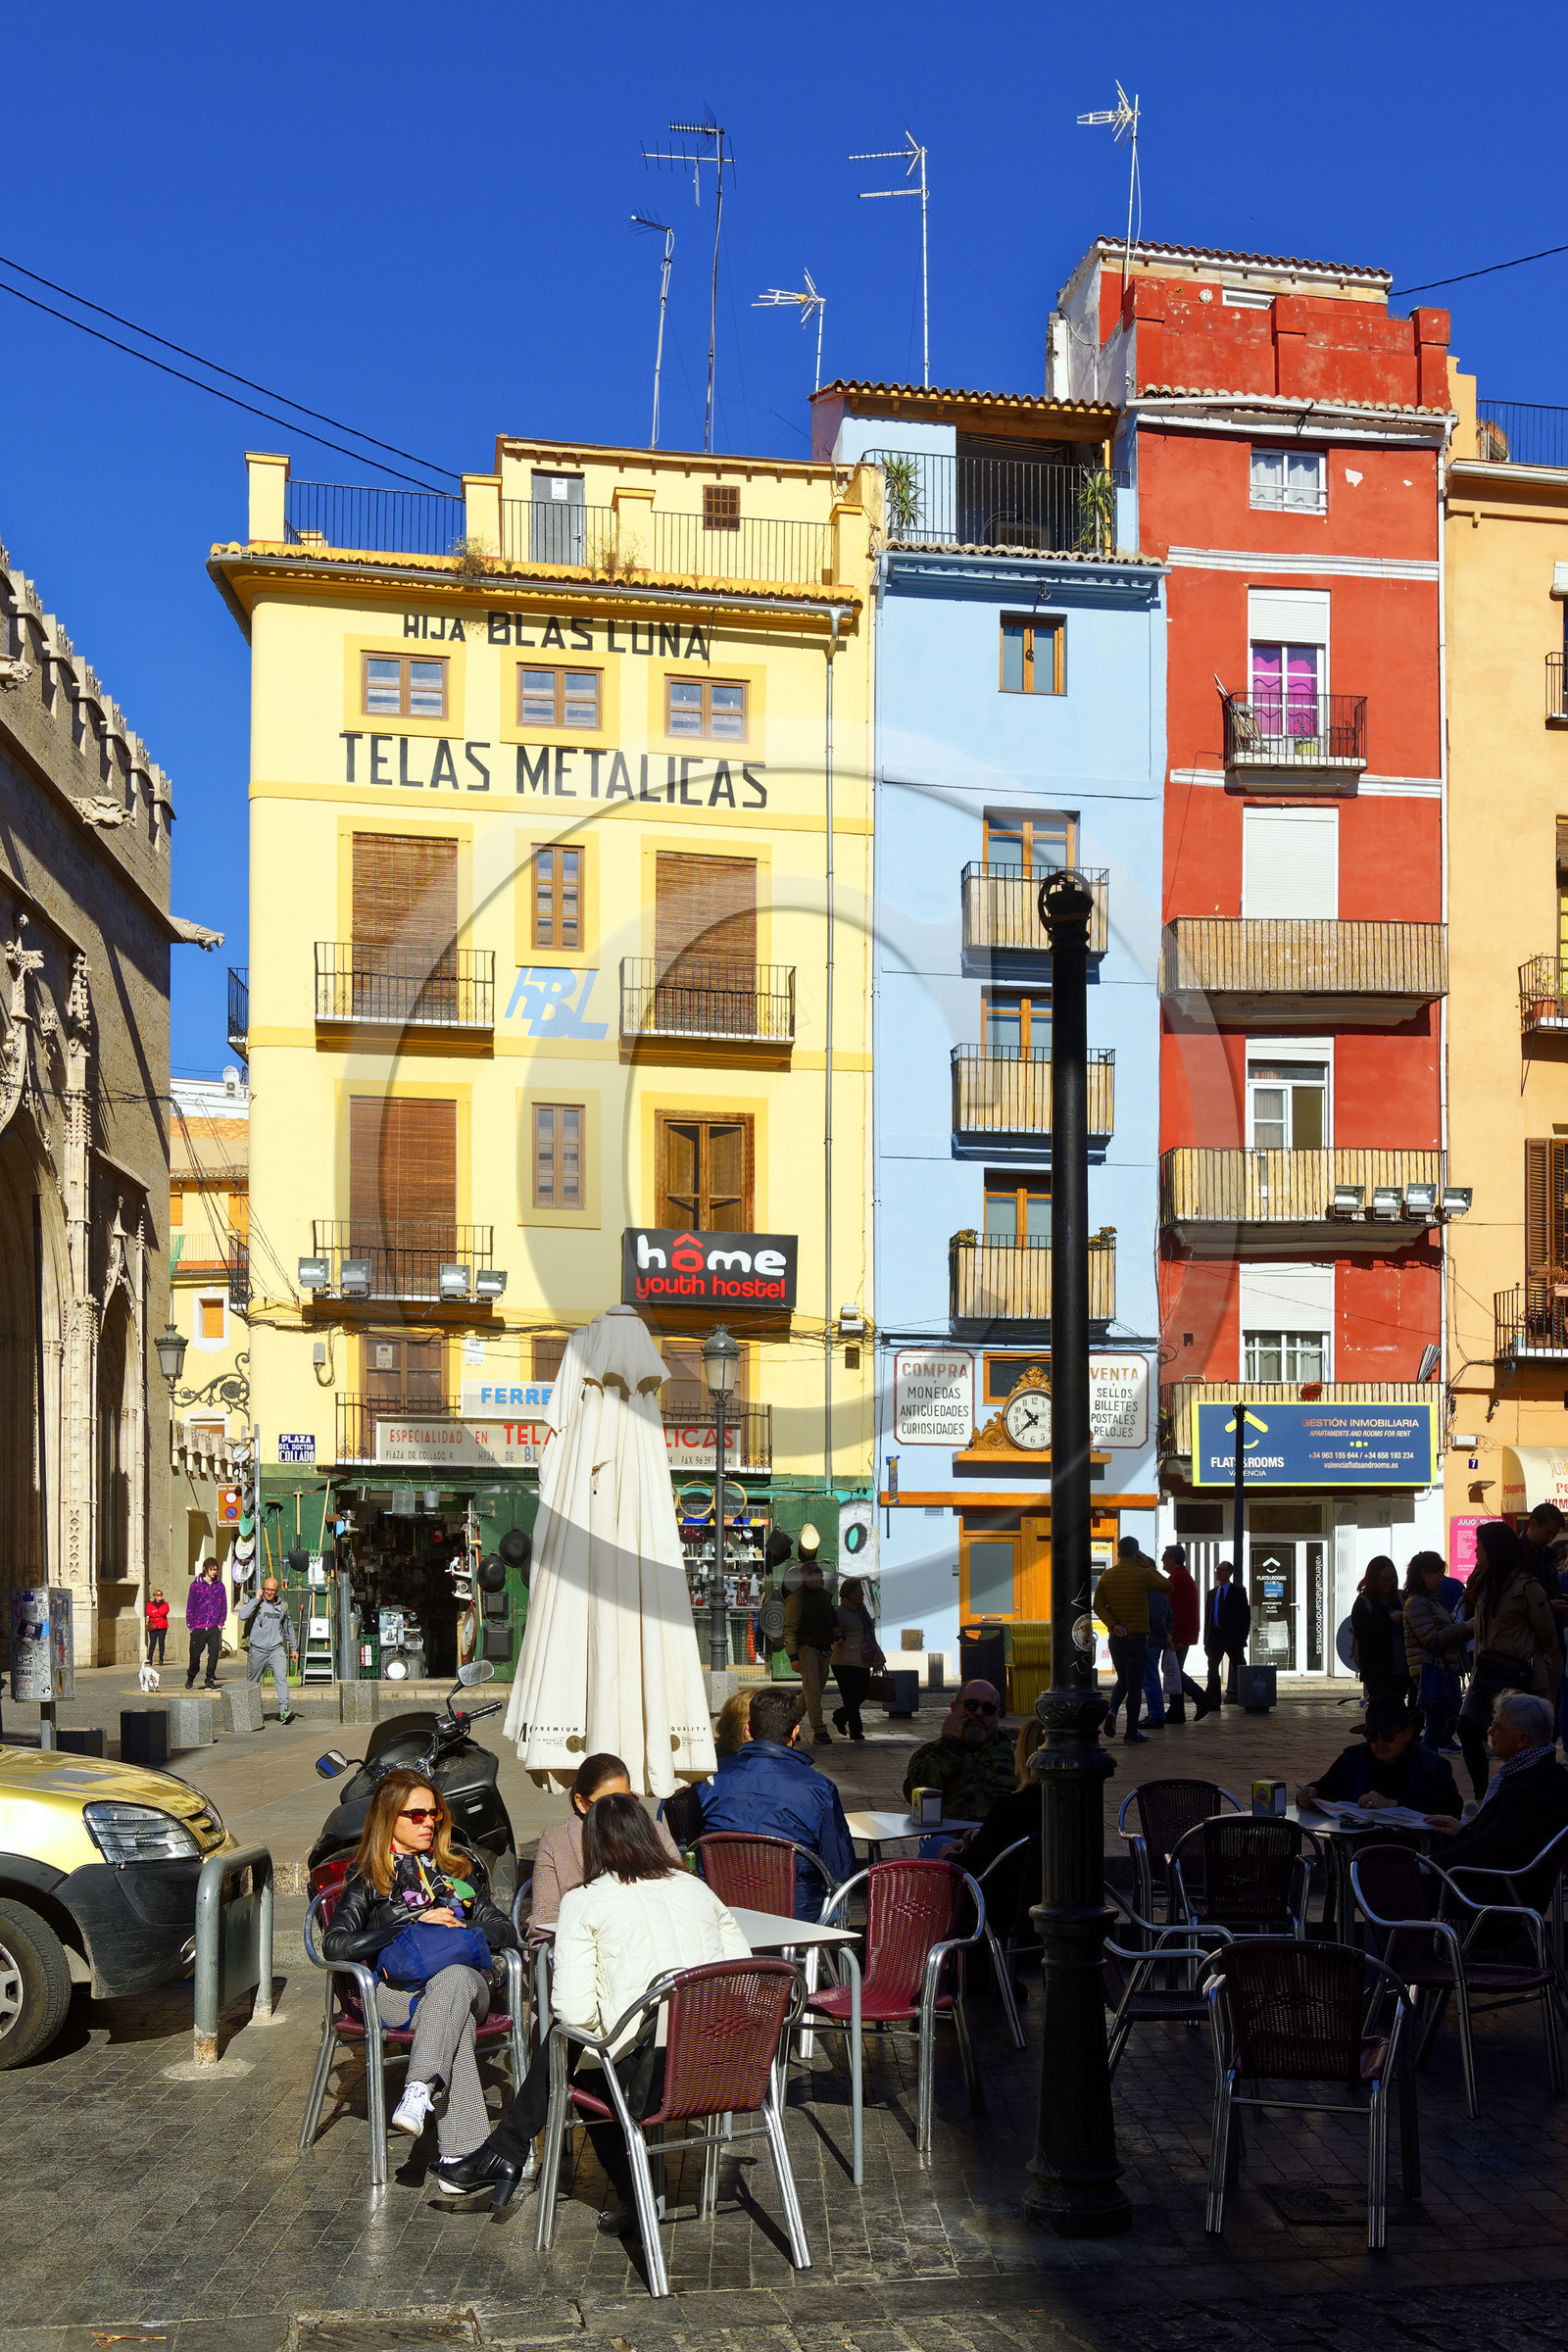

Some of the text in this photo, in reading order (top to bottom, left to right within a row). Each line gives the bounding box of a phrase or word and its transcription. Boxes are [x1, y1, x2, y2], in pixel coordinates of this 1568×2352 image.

[403, 611, 710, 662] HIJA BLAS LUNA
[338, 732, 767, 809] TELAS METALICAS
[635, 1274, 786, 1299] youth hostel
[902, 1361, 968, 1380] COMPRA
[1090, 1367, 1140, 1382] VENTA
[480, 1388, 554, 1404] FERRE
[906, 1386, 961, 1399] MONEDAS
[1097, 1388, 1134, 1399] SELLOS
[900, 1402, 969, 1418] ANTIGÜEDADES
[1094, 1399, 1139, 1413] BILLETES
[1091, 1412, 1136, 1426] POSTALES
[1300, 1416, 1420, 1428] GESTIÓN INMOBILIARIA
[389, 1424, 734, 1448] ESPECIALIDAD EN TEL LICAS
[901, 1422, 965, 1436] CURIOSIDADES
[1094, 1426, 1134, 1439] RELOJES
[281, 1435, 312, 1444] PLAZA
[279, 1449, 315, 1462] COLLADO
[385, 1449, 405, 1459] PLAZA
[505, 1451, 514, 1461] DE
[524, 1446, 546, 1462] BL
[681, 1455, 693, 1465] FAX
[1471, 1459, 1477, 1469] 7
